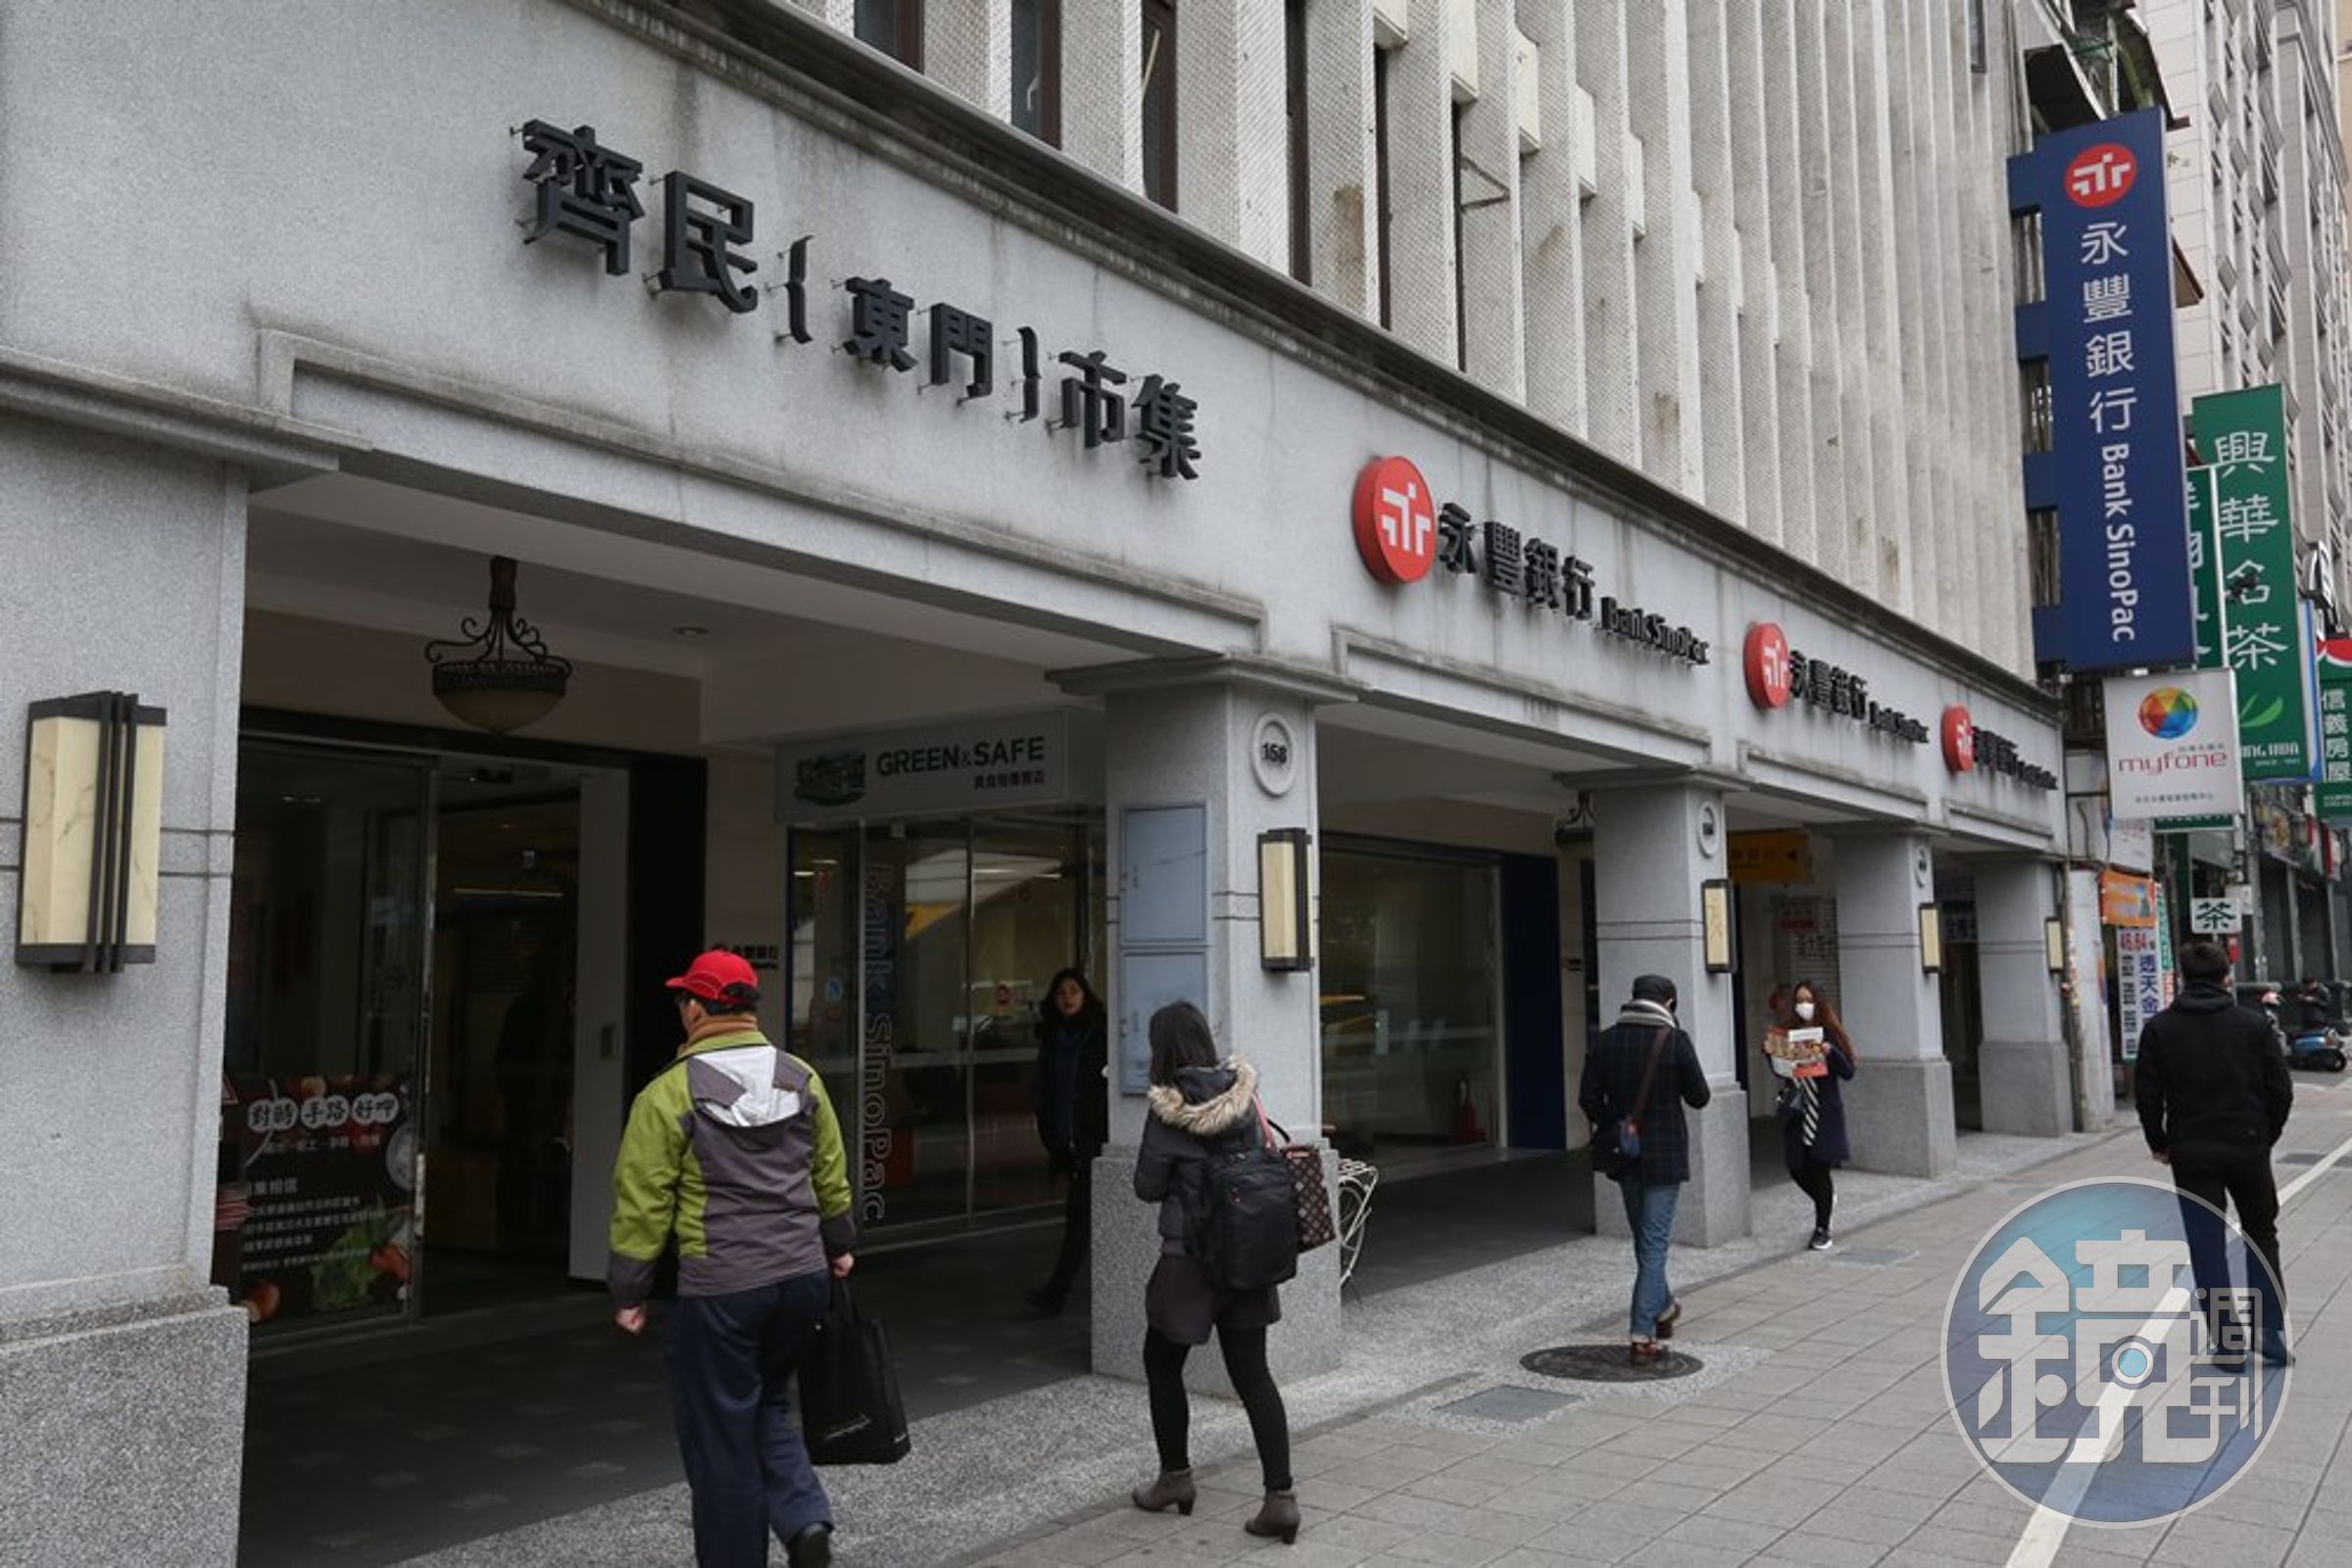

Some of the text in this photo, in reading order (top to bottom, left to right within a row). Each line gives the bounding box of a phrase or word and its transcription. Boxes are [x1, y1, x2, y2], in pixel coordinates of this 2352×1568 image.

[2081, 221, 2138, 433] 永豐銀行
[1438, 503, 1595, 621] 永豐銀行
[2102, 442, 2138, 642] Bank SinoPac
[2215, 431, 2288, 670] 興華名茶
[2119, 751, 2229, 776] myfone
[2196, 902, 2236, 930] 茶
